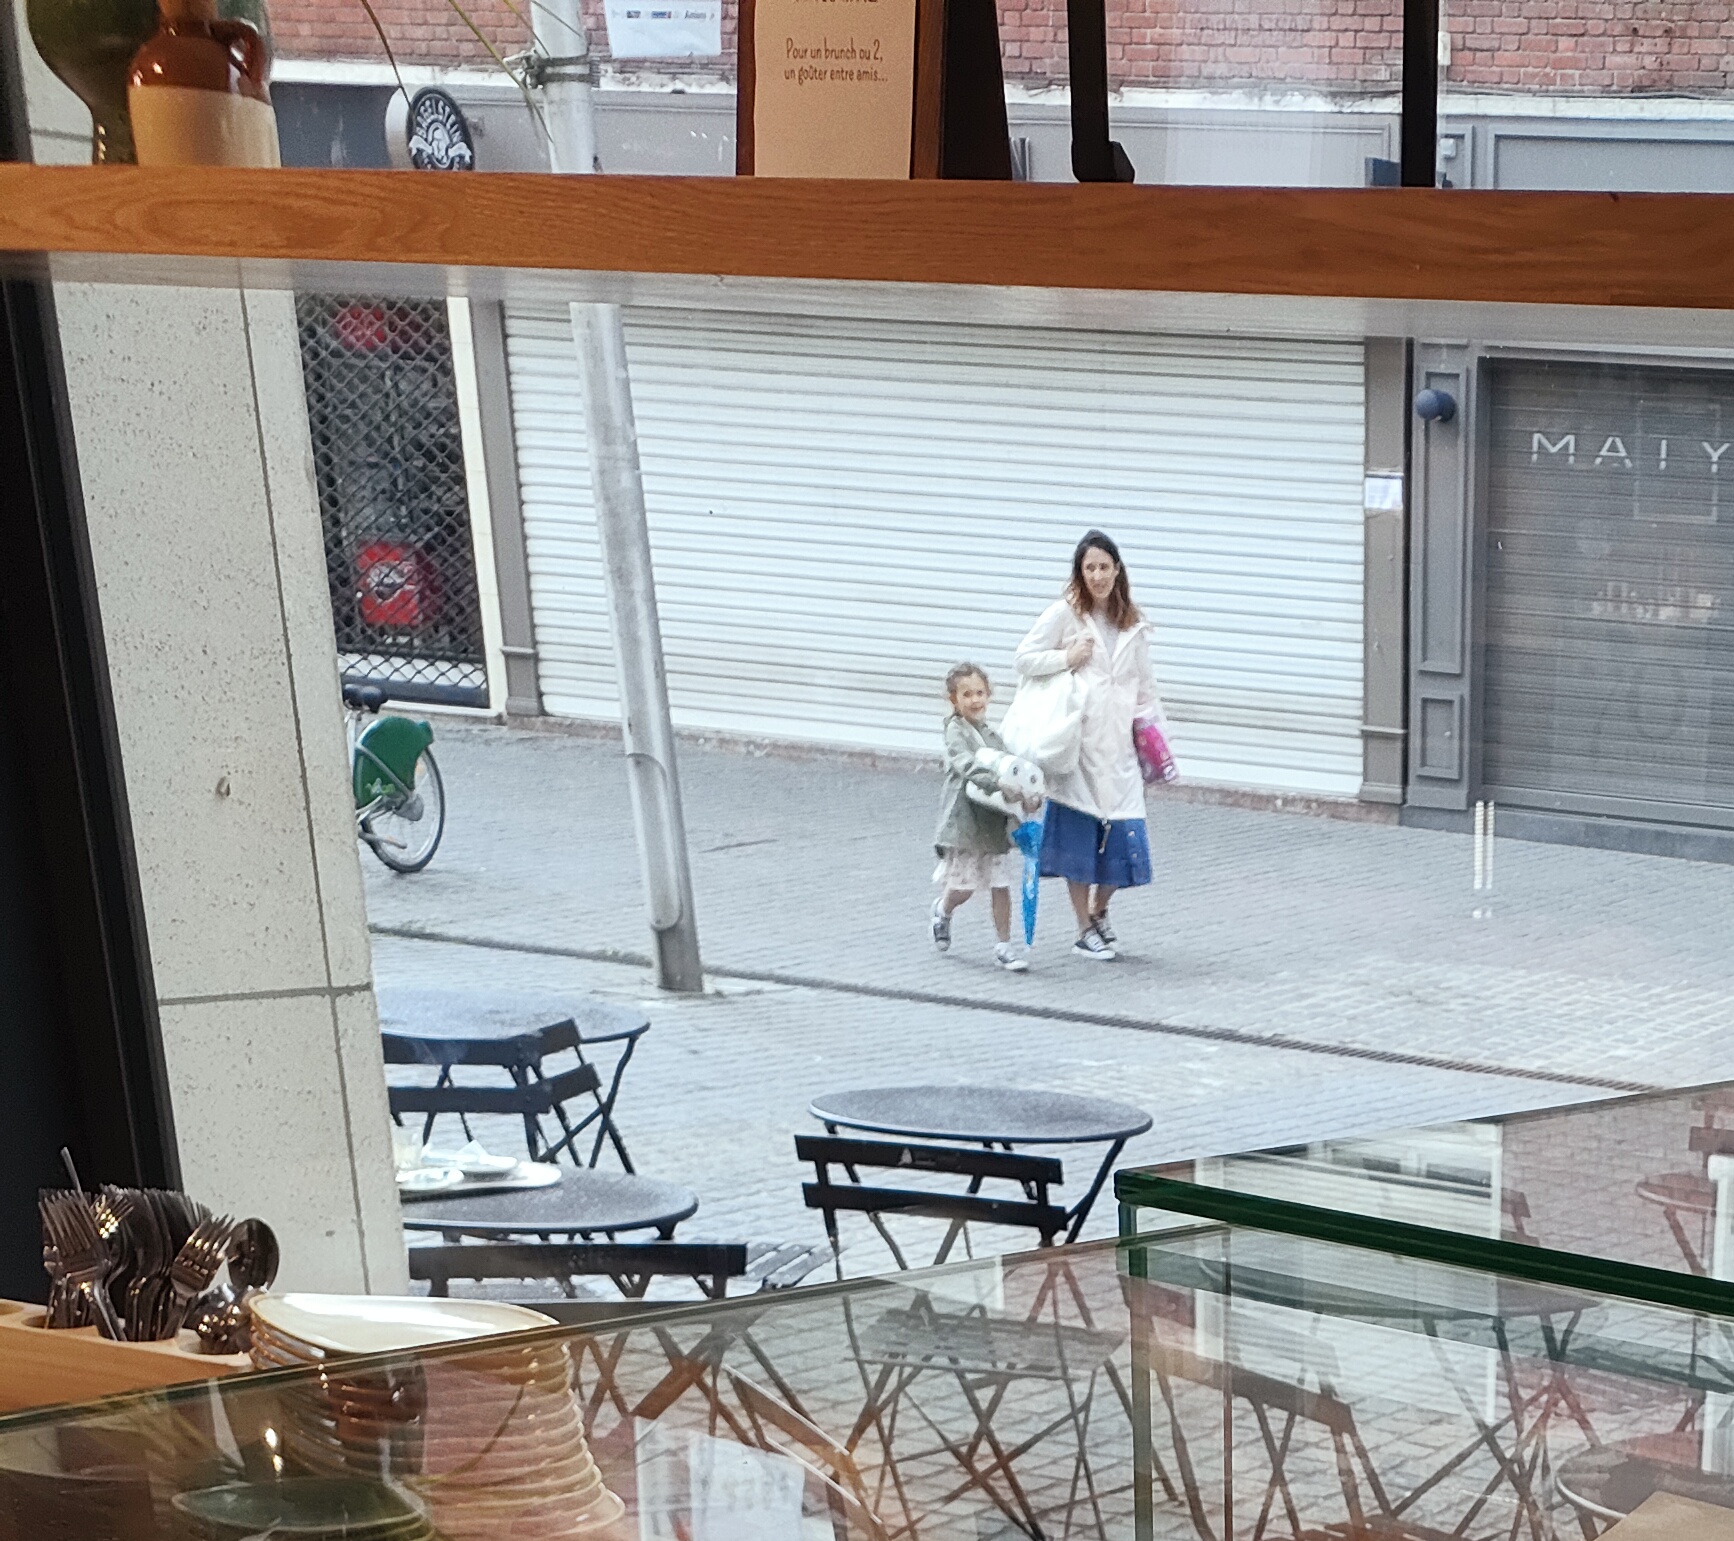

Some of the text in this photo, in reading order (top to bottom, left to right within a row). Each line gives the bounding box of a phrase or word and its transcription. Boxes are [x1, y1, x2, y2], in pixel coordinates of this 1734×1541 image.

[786, 37, 884, 62] Pour un brunch ou 2,
[784, 65, 889, 86] un goûter entre amis...
[1531, 432, 1731, 473] MAIY
